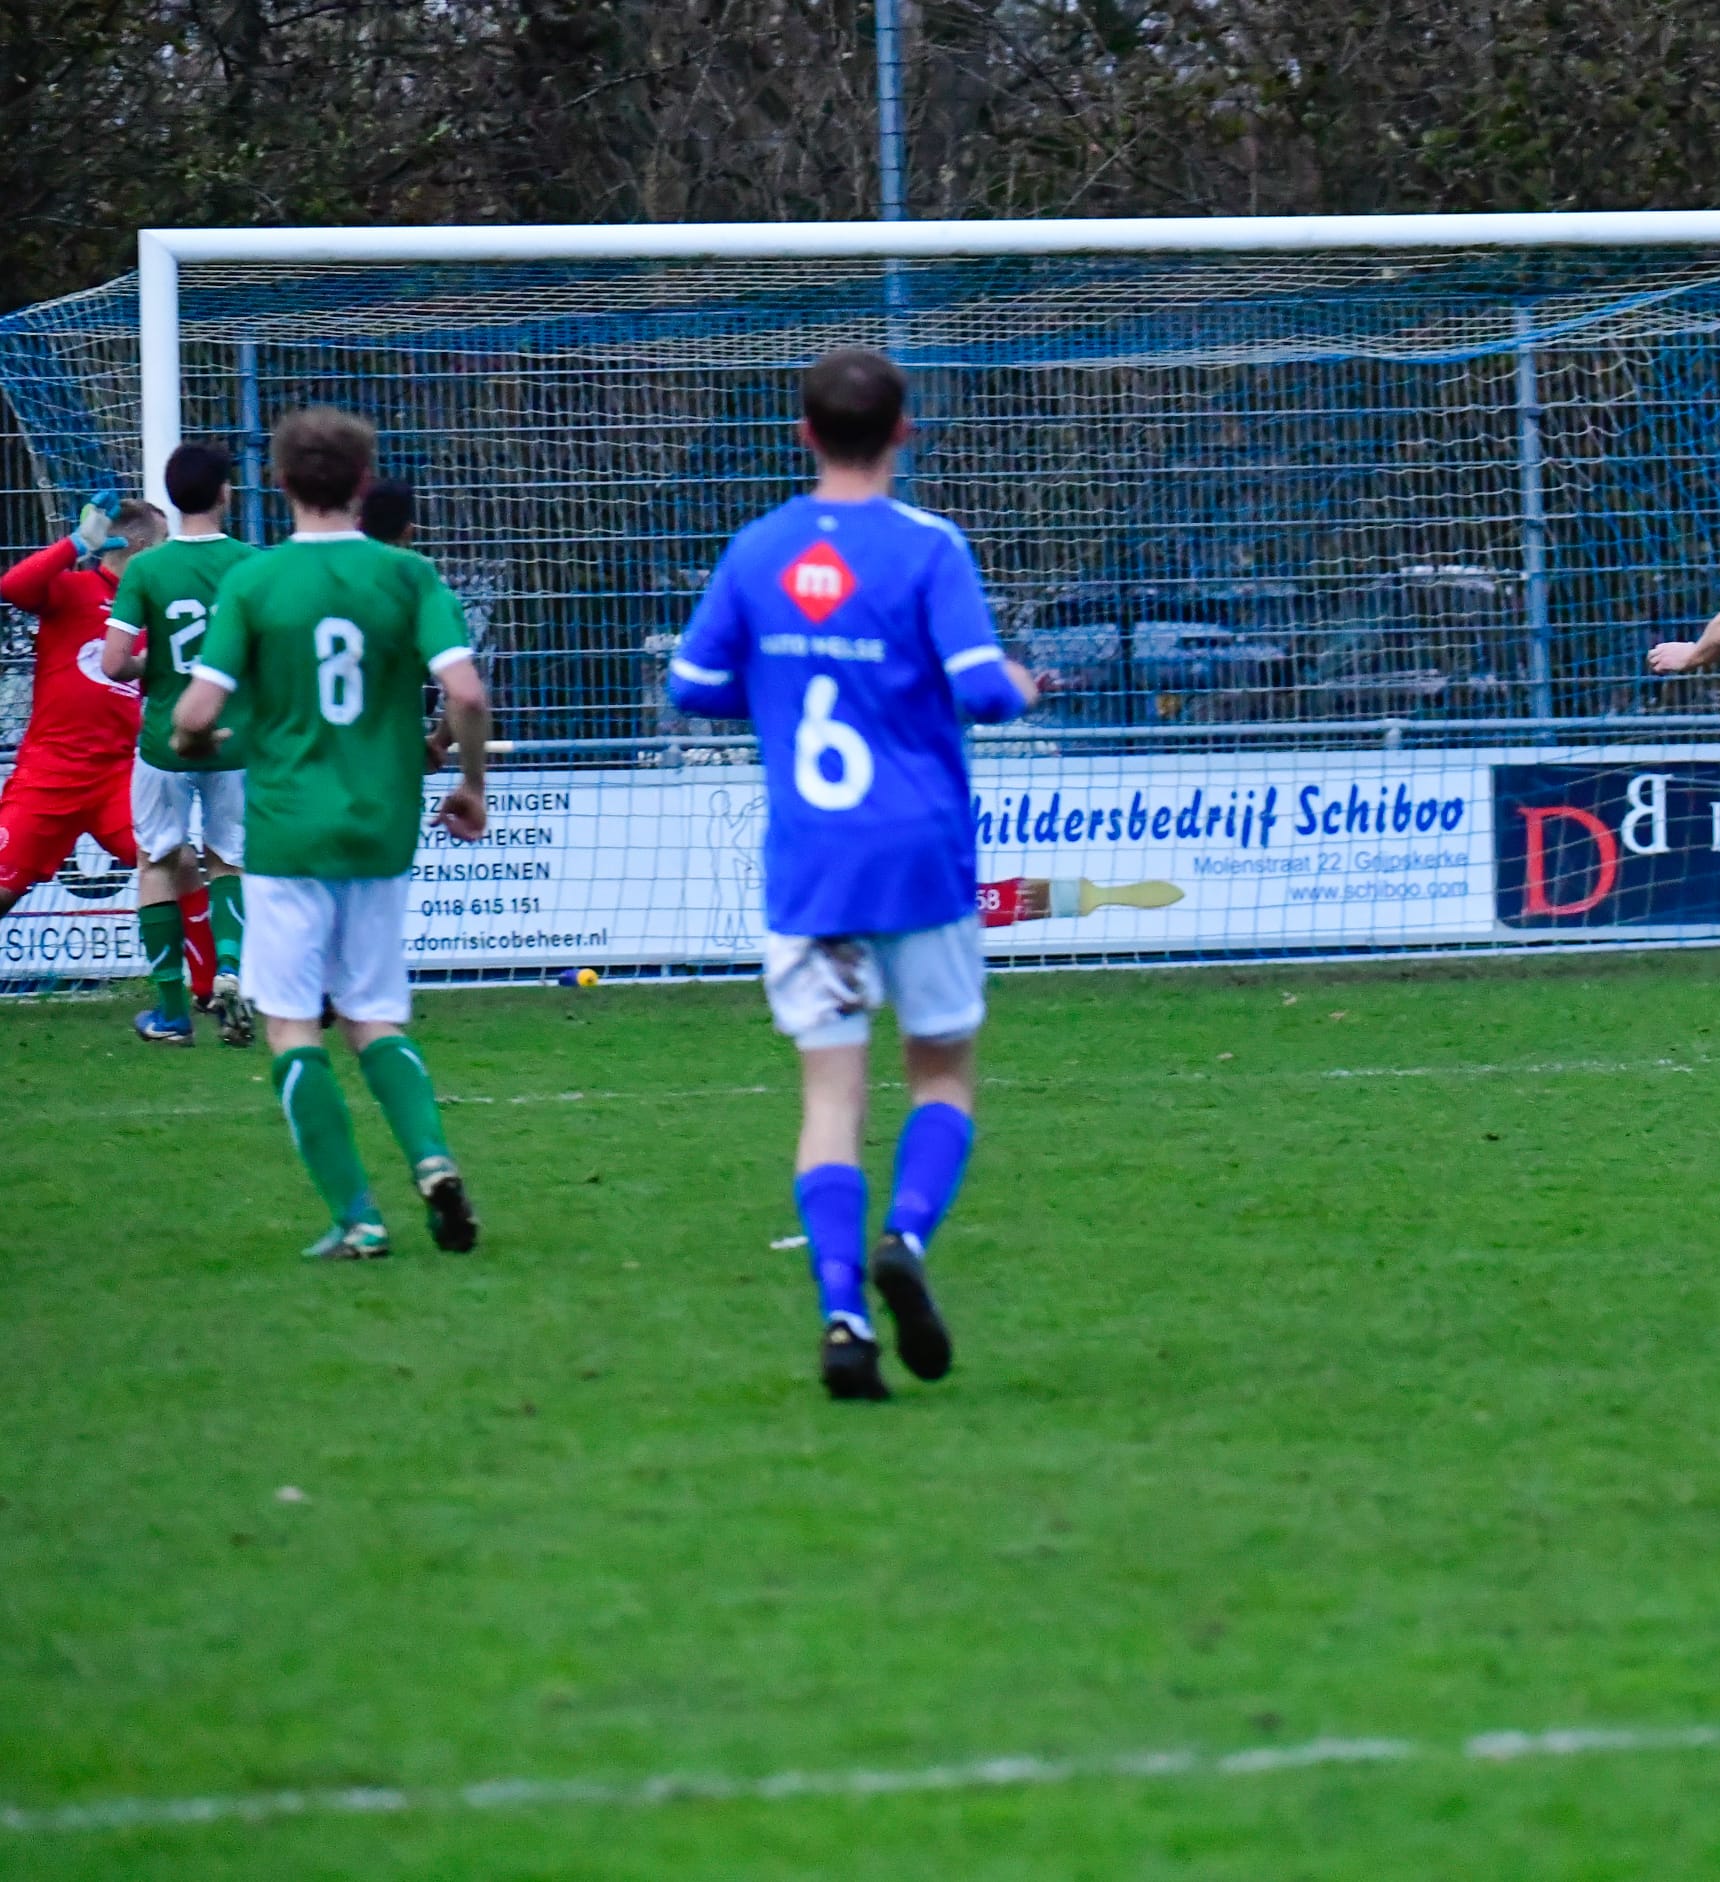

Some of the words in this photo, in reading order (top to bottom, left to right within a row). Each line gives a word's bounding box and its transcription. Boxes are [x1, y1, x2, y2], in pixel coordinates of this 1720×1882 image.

[796, 563, 843, 598] m
[314, 617, 365, 726] 8
[795, 674, 874, 811] 6
[973, 786, 1277, 849] hildersbedrijf
[1295, 783, 1465, 836] Schiboo
[410, 862, 551, 881] PENSIOENEN
[1318, 851, 1342, 871] 22
[1289, 879, 1469, 901] www.schiboo.com
[421, 899, 464, 917] 0118
[471, 897, 505, 915] 615
[511, 896, 541, 914] 151
[404, 928, 608, 951] .donrisicobeheer.nl
